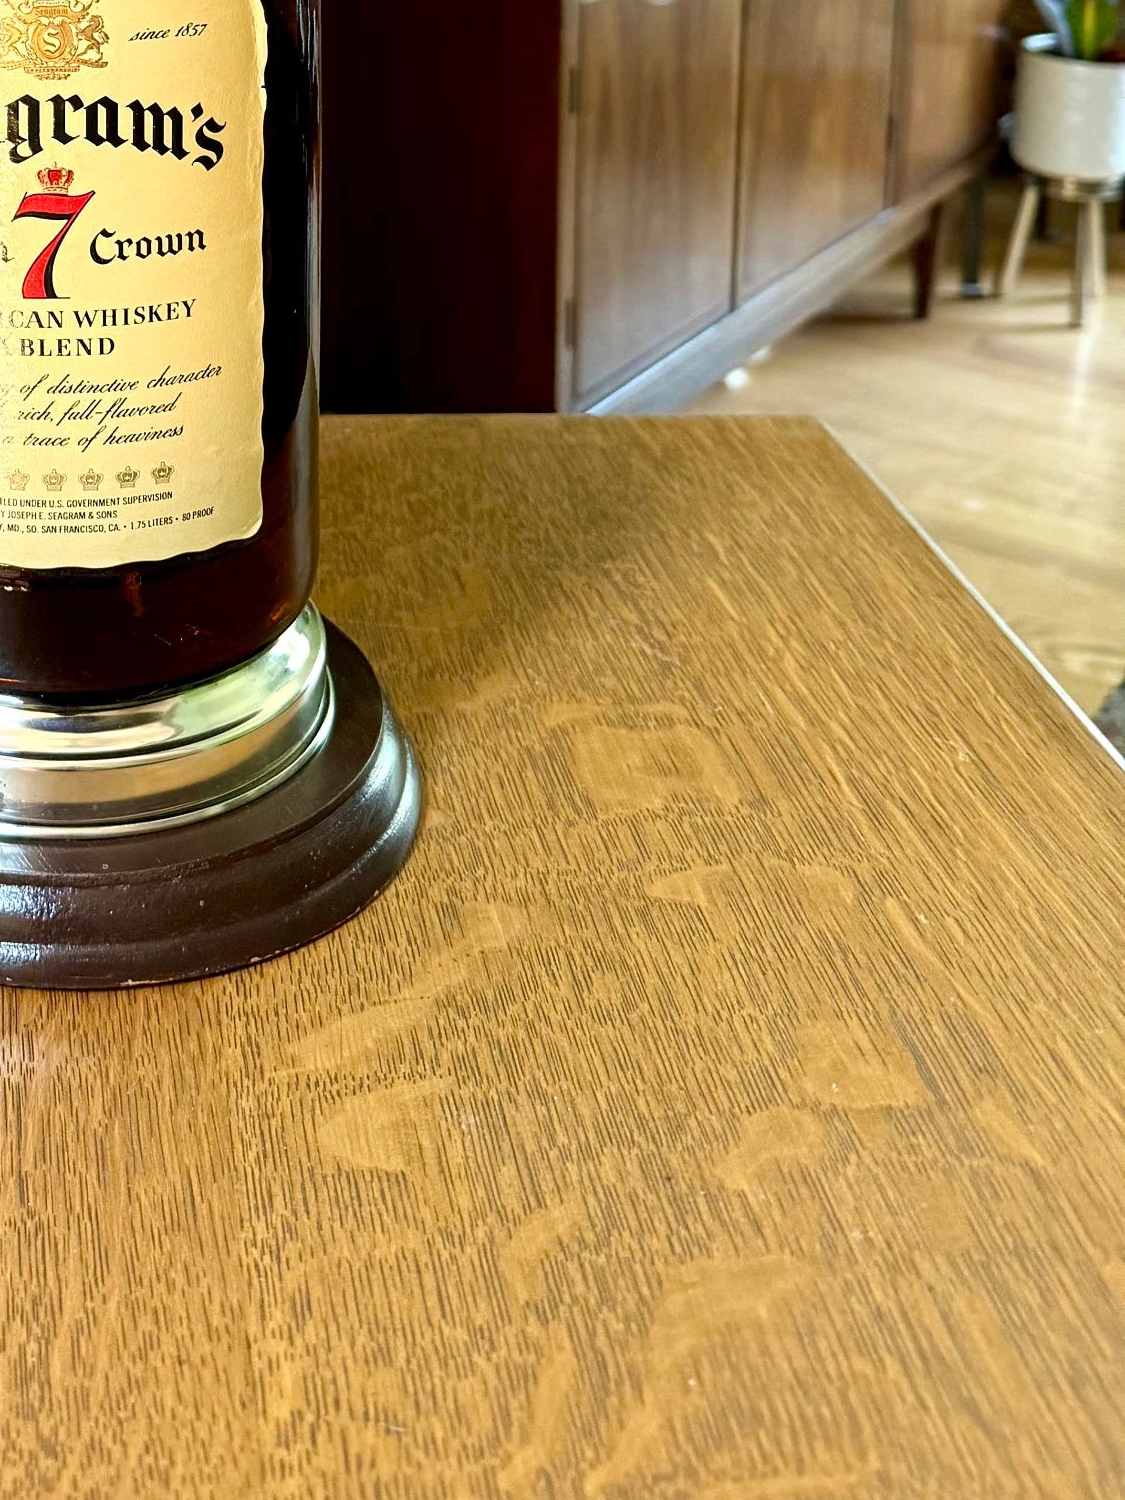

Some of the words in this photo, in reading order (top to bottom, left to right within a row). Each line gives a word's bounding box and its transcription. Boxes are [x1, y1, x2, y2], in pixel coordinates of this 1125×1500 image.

[128, 27, 170, 42] since
[173, 23, 207, 38] 1857
[11, 189, 96, 299] 7
[89, 227, 206, 266] Crown
[74, 298, 197, 328] WHISKEY
[19, 337, 116, 357] BLEND
[19, 373, 50, 401] of
[46, 373, 140, 395] distinctive
[147, 363, 223, 389] character
[56, 392, 183, 427] full-flavored
[23, 433, 69, 447] trace
[77, 425, 107, 453] of
[102, 425, 184, 446] heaviness
[20, 499, 47, 508] UNDER
[49, 499, 64, 508] U.S.
[66, 498, 120, 508] GOVERNMENT
[122, 491, 173, 505] SUPERVISION
[7, 510, 37, 520] JOSEPH
[48, 511, 86, 520] SEAGRAM
[88, 511, 94, 519] &
[96, 510, 118, 519] SONS
[26, 524, 39, 534] SO.
[41, 524, 57, 534] SAN
[59, 524, 107, 534] FRANCISCO,
[108, 523, 121, 532] CA.
[130, 520, 146, 530] 1.75
[147, 516, 173, 528] LITERS
[181, 512, 191, 521] 80
[192, 505, 215, 520] PROOF
